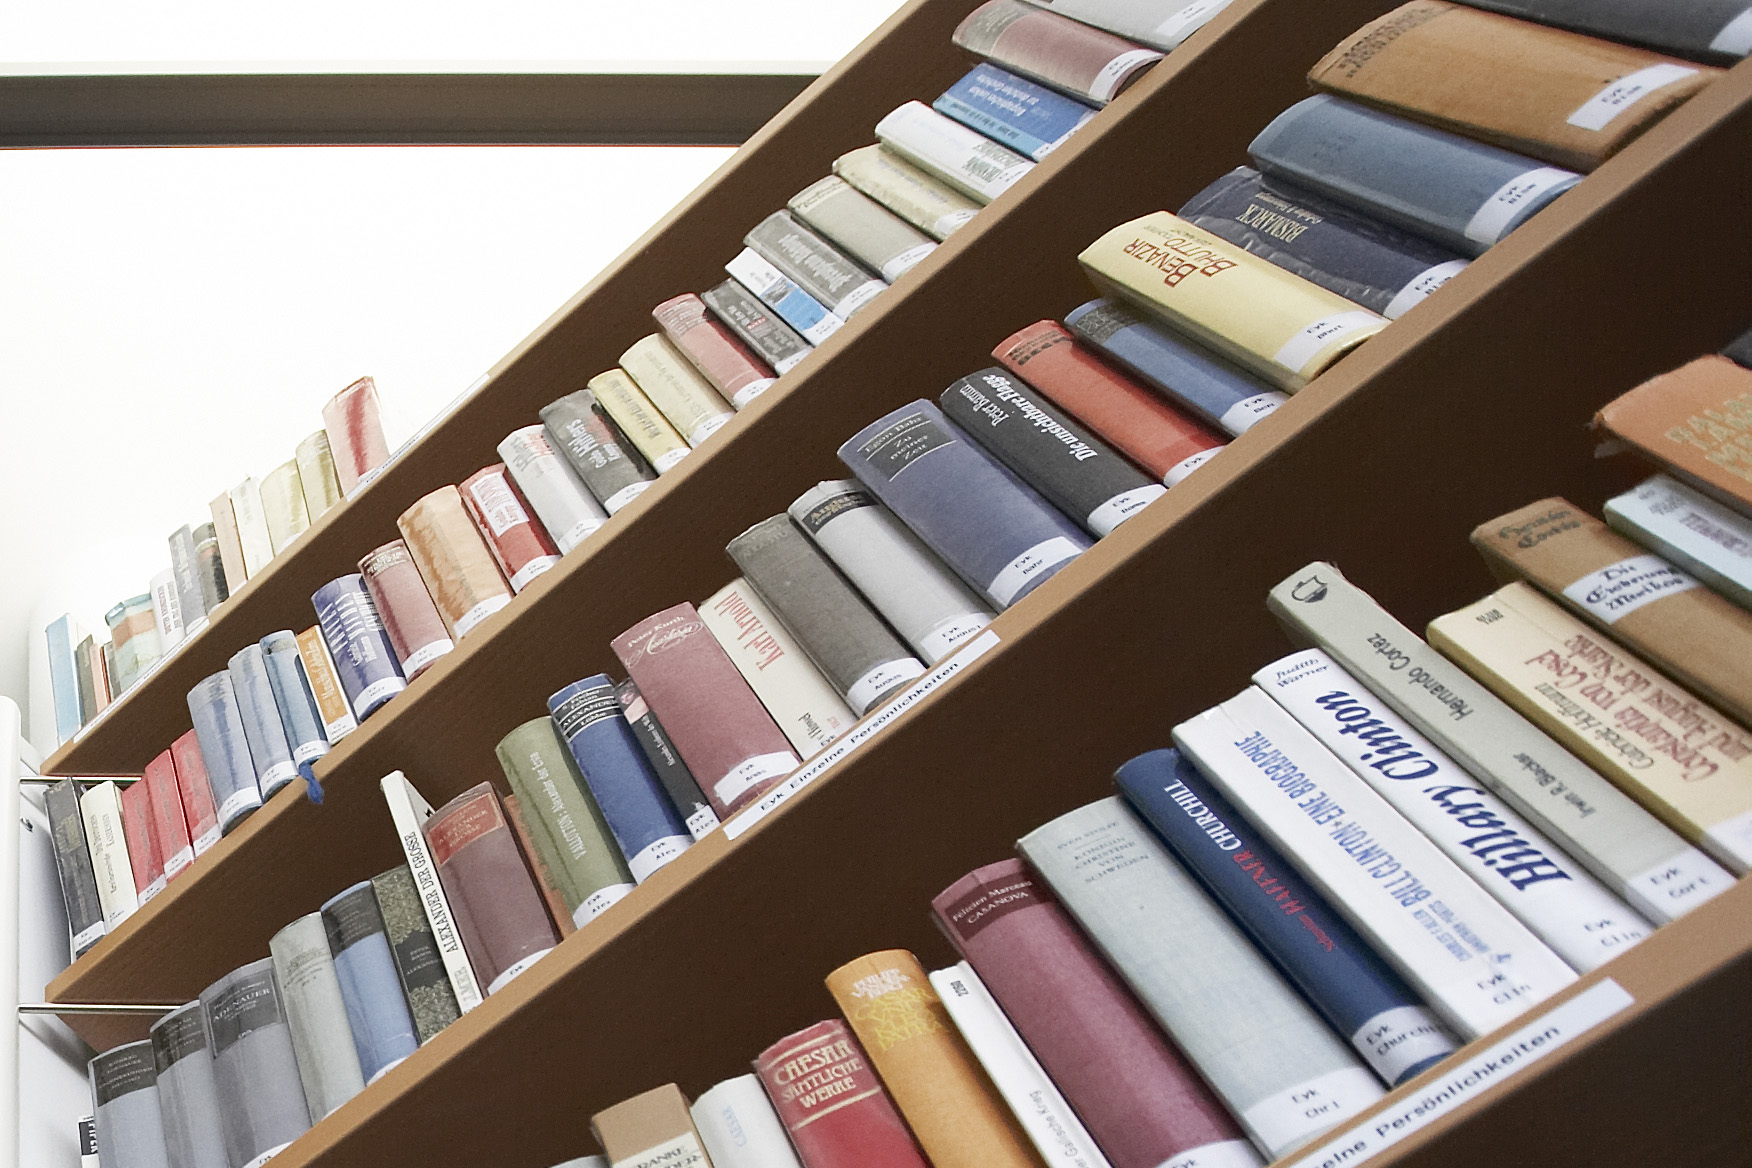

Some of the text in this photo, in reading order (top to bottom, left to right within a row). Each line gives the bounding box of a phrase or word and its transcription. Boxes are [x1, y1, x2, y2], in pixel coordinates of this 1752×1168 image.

[1163, 237, 1239, 278] BHUTTO
[1235, 203, 1310, 244] BISMARCK
[1122, 237, 1199, 289] BENAZIR
[1069, 441, 1098, 462] Die
[713, 590, 786, 673] Karl Arnold
[1367, 633, 1475, 721] Hernando Cortez
[758, 658, 960, 812] Eyk Einzelne Persönlichkeiten
[1164, 778, 1243, 851] CHURCHILL
[1230, 723, 1432, 914] BILL CLINTON EINE BIOGRAPHIE
[1316, 689, 1571, 891] Hillary Clinton
[403, 831, 459, 953] ALEXANDER DER GROSSE
[967, 891, 1029, 925] CASANOVA
[773, 1039, 855, 1086] CAESAR
[1373, 1020, 1563, 1141] Persönlichkeiten
